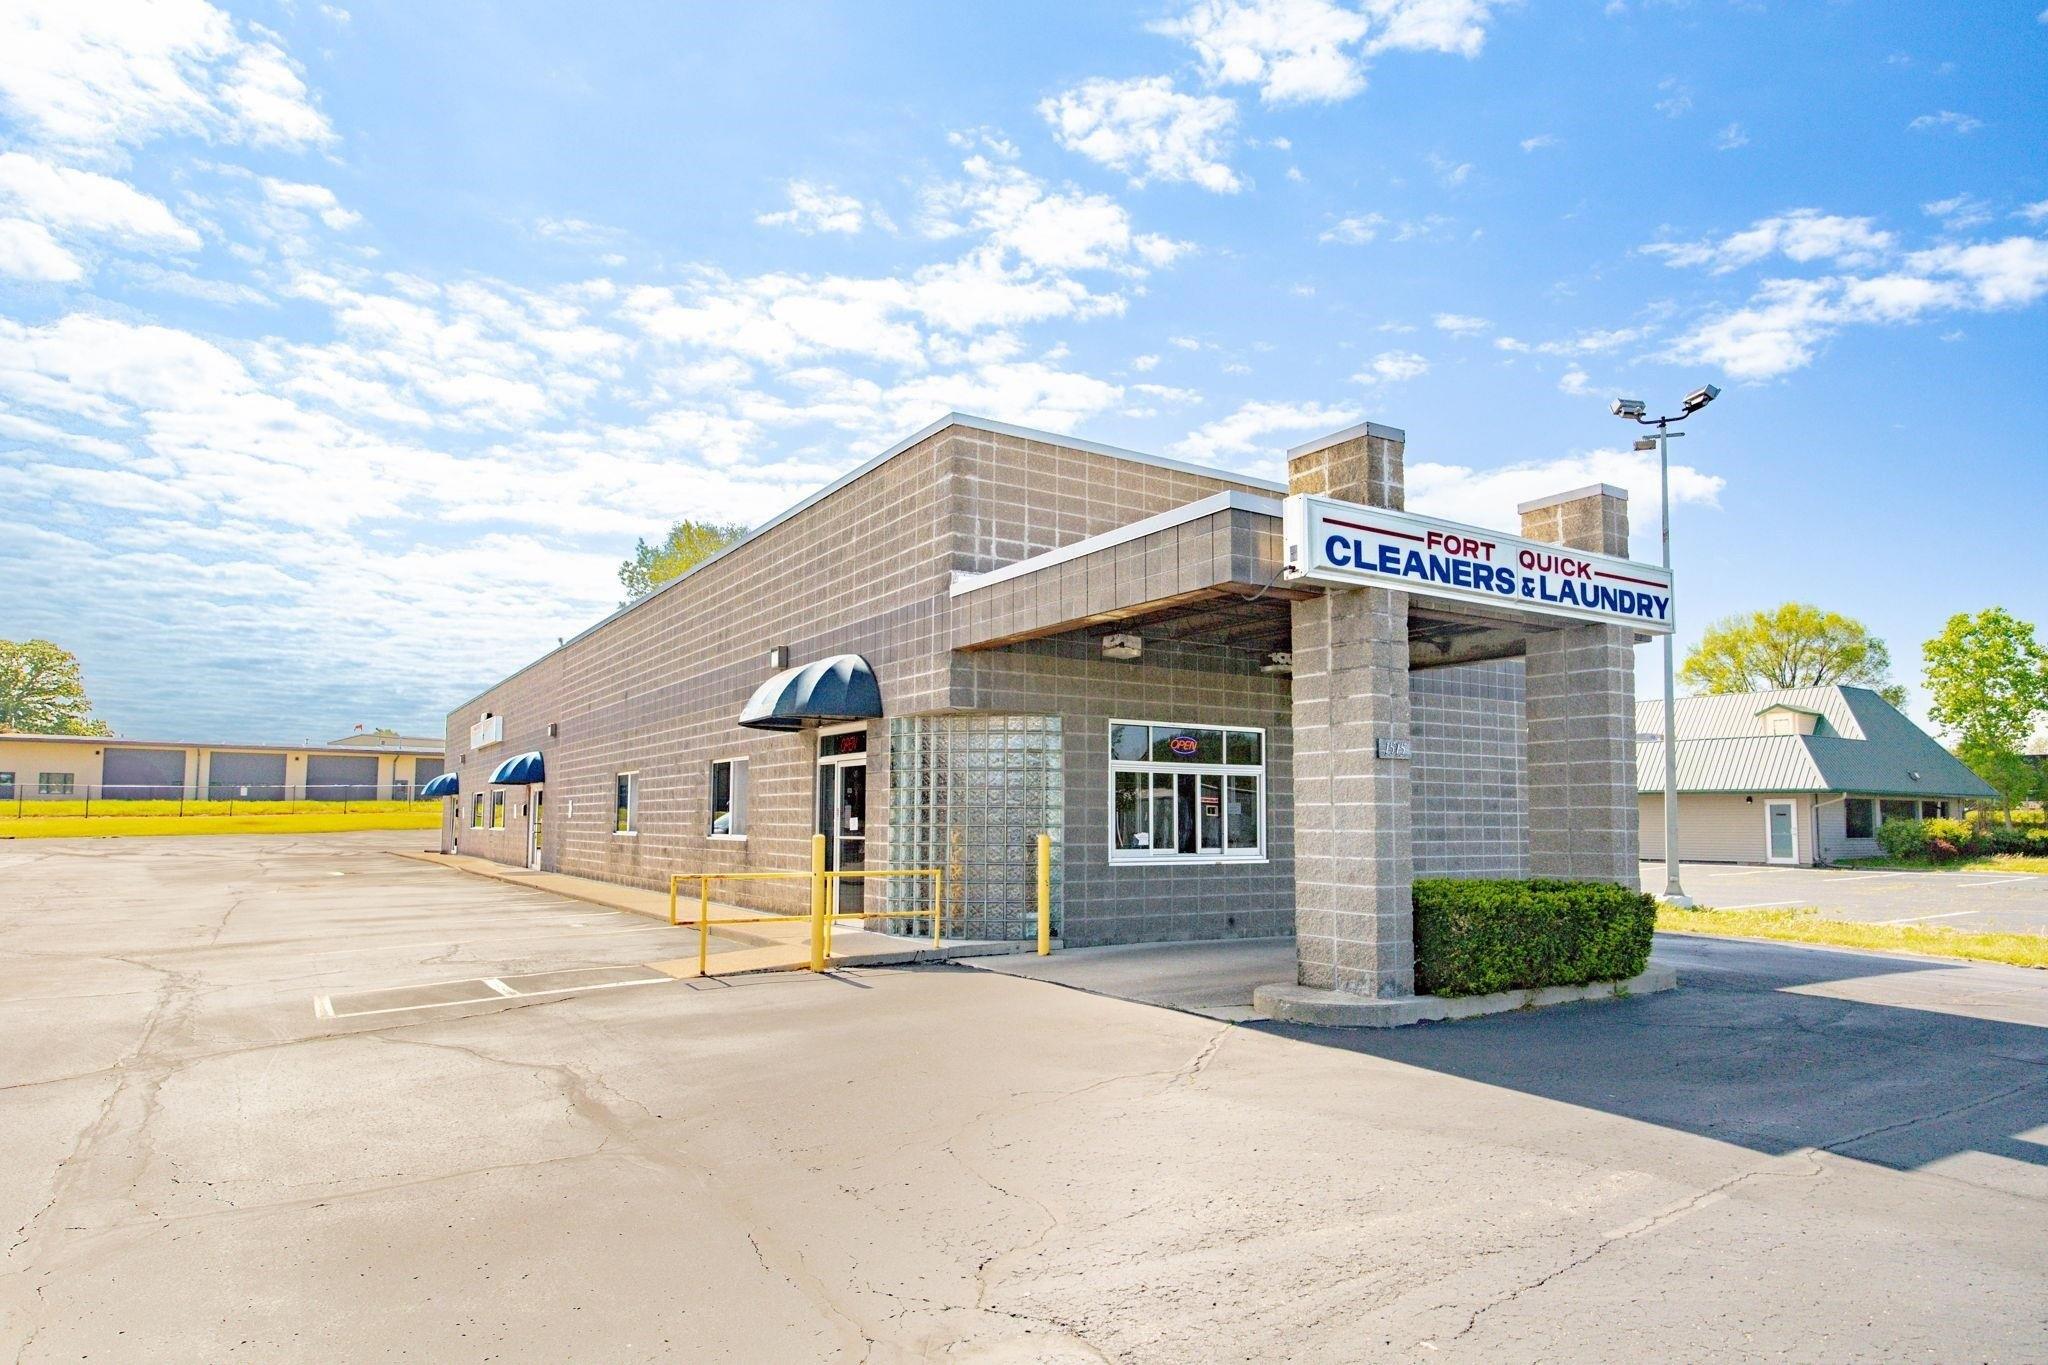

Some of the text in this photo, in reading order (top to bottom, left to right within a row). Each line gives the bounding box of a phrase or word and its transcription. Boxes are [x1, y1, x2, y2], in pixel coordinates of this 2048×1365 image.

[1325, 534, 1516, 595] CLEANERS
[1540, 575, 1670, 620] LAUNDRY
[1426, 531, 1592, 581] FORT QUICK
[1170, 739, 1198, 751] OPEN
